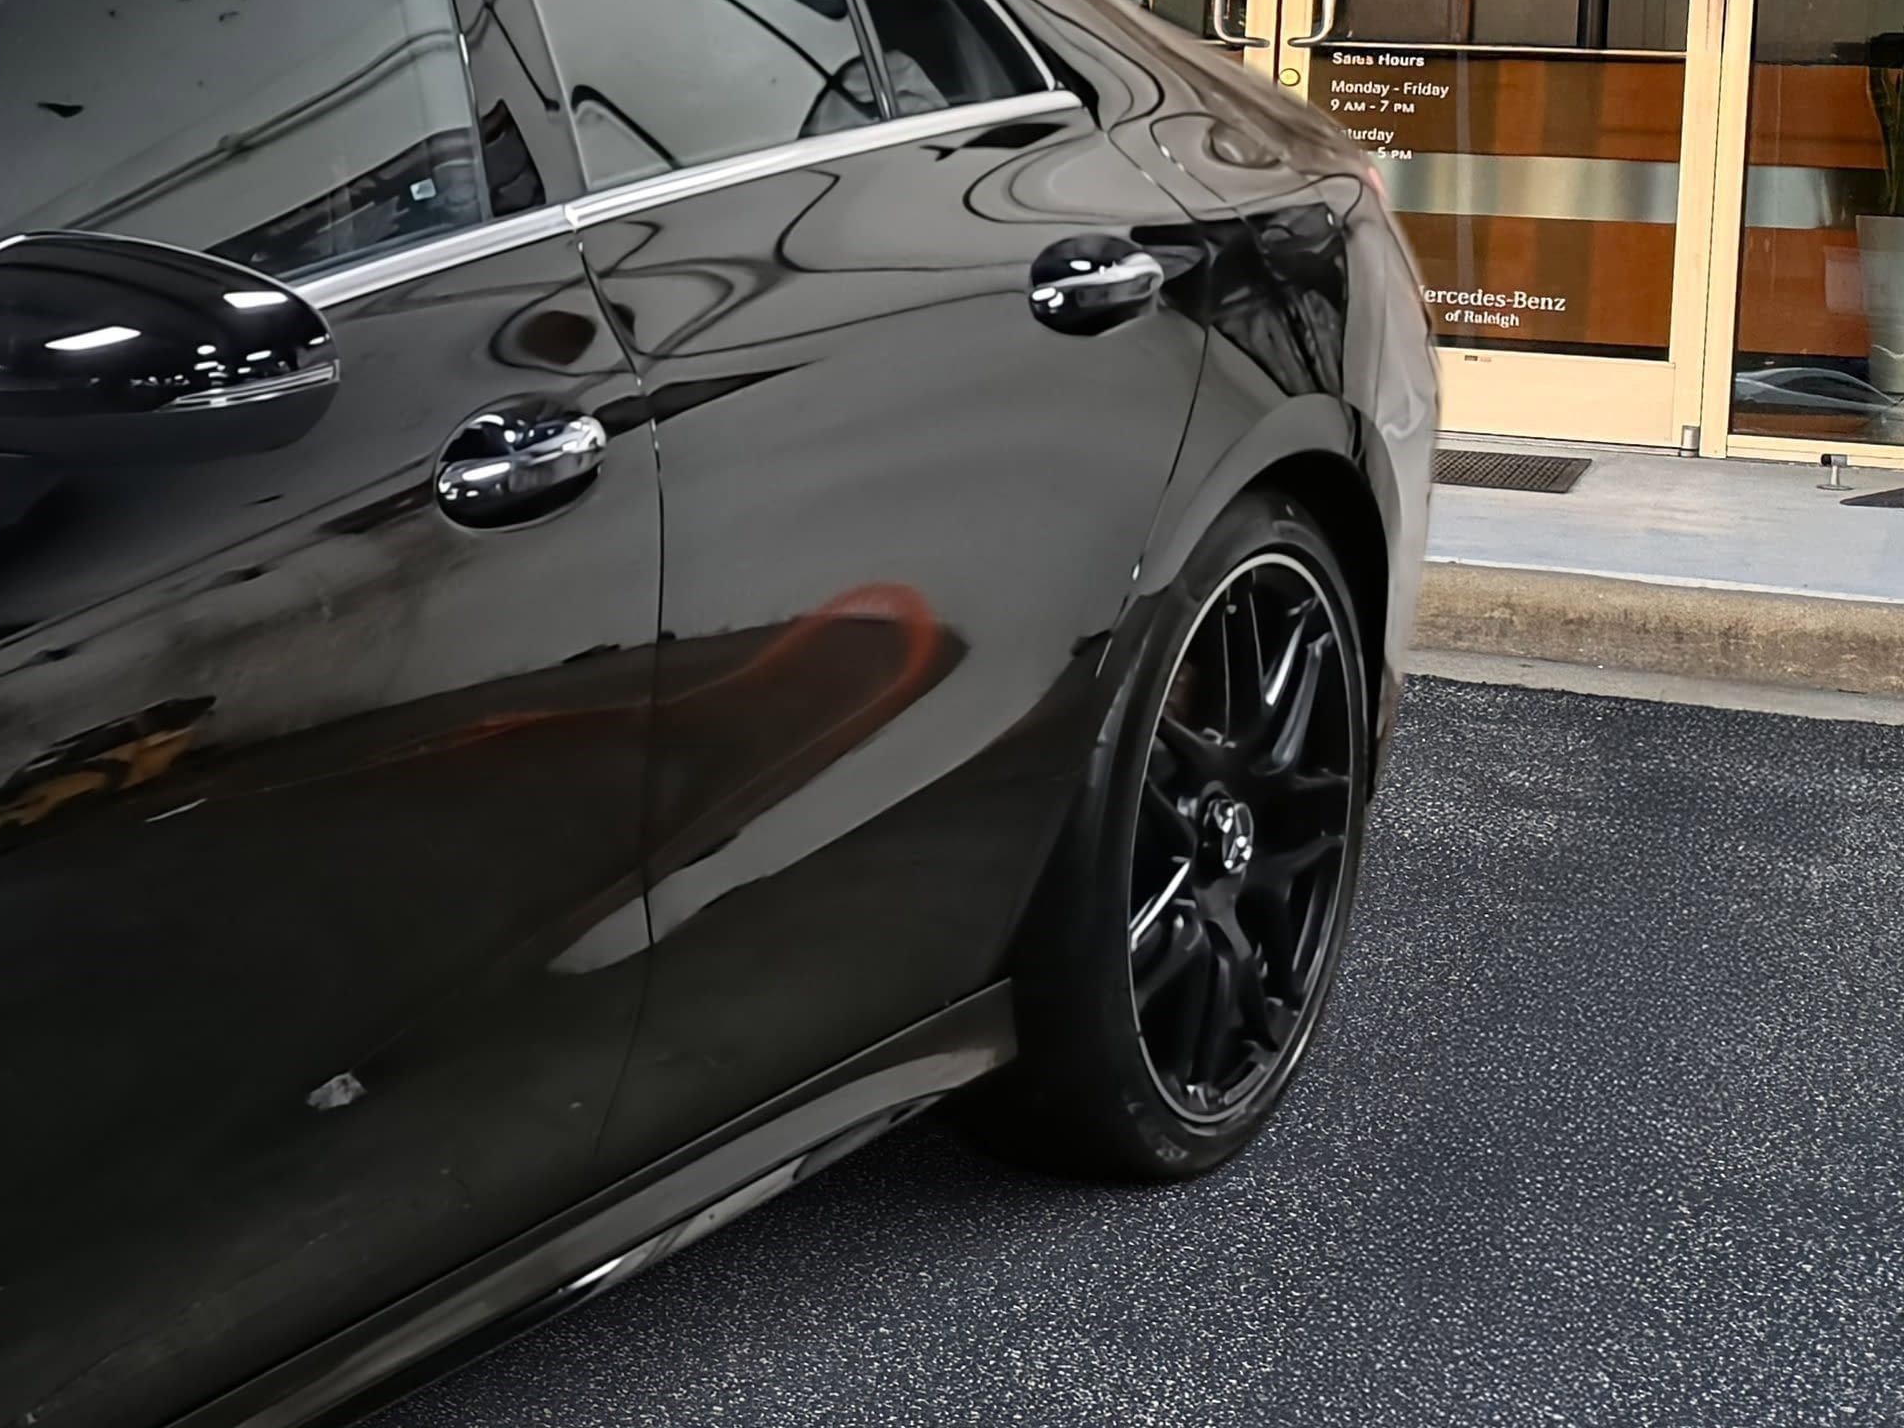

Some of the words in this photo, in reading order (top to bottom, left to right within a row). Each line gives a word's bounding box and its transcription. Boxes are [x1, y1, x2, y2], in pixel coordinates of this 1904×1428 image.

[1377, 53, 1425, 67] Hours
[1331, 80, 1390, 97] Monday
[1403, 82, 1450, 99] Friday
[1330, 98, 1340, 111] 9
[1343, 101, 1366, 112] AM
[1379, 99, 1389, 113] 7
[1393, 103, 1415, 114] PM
[1341, 128, 1394, 144] turday
[1377, 146, 1387, 159] 5
[1391, 150, 1413, 160] PM
[1445, 310, 1461, 322] of
[1464, 310, 1520, 328] Raleigh
